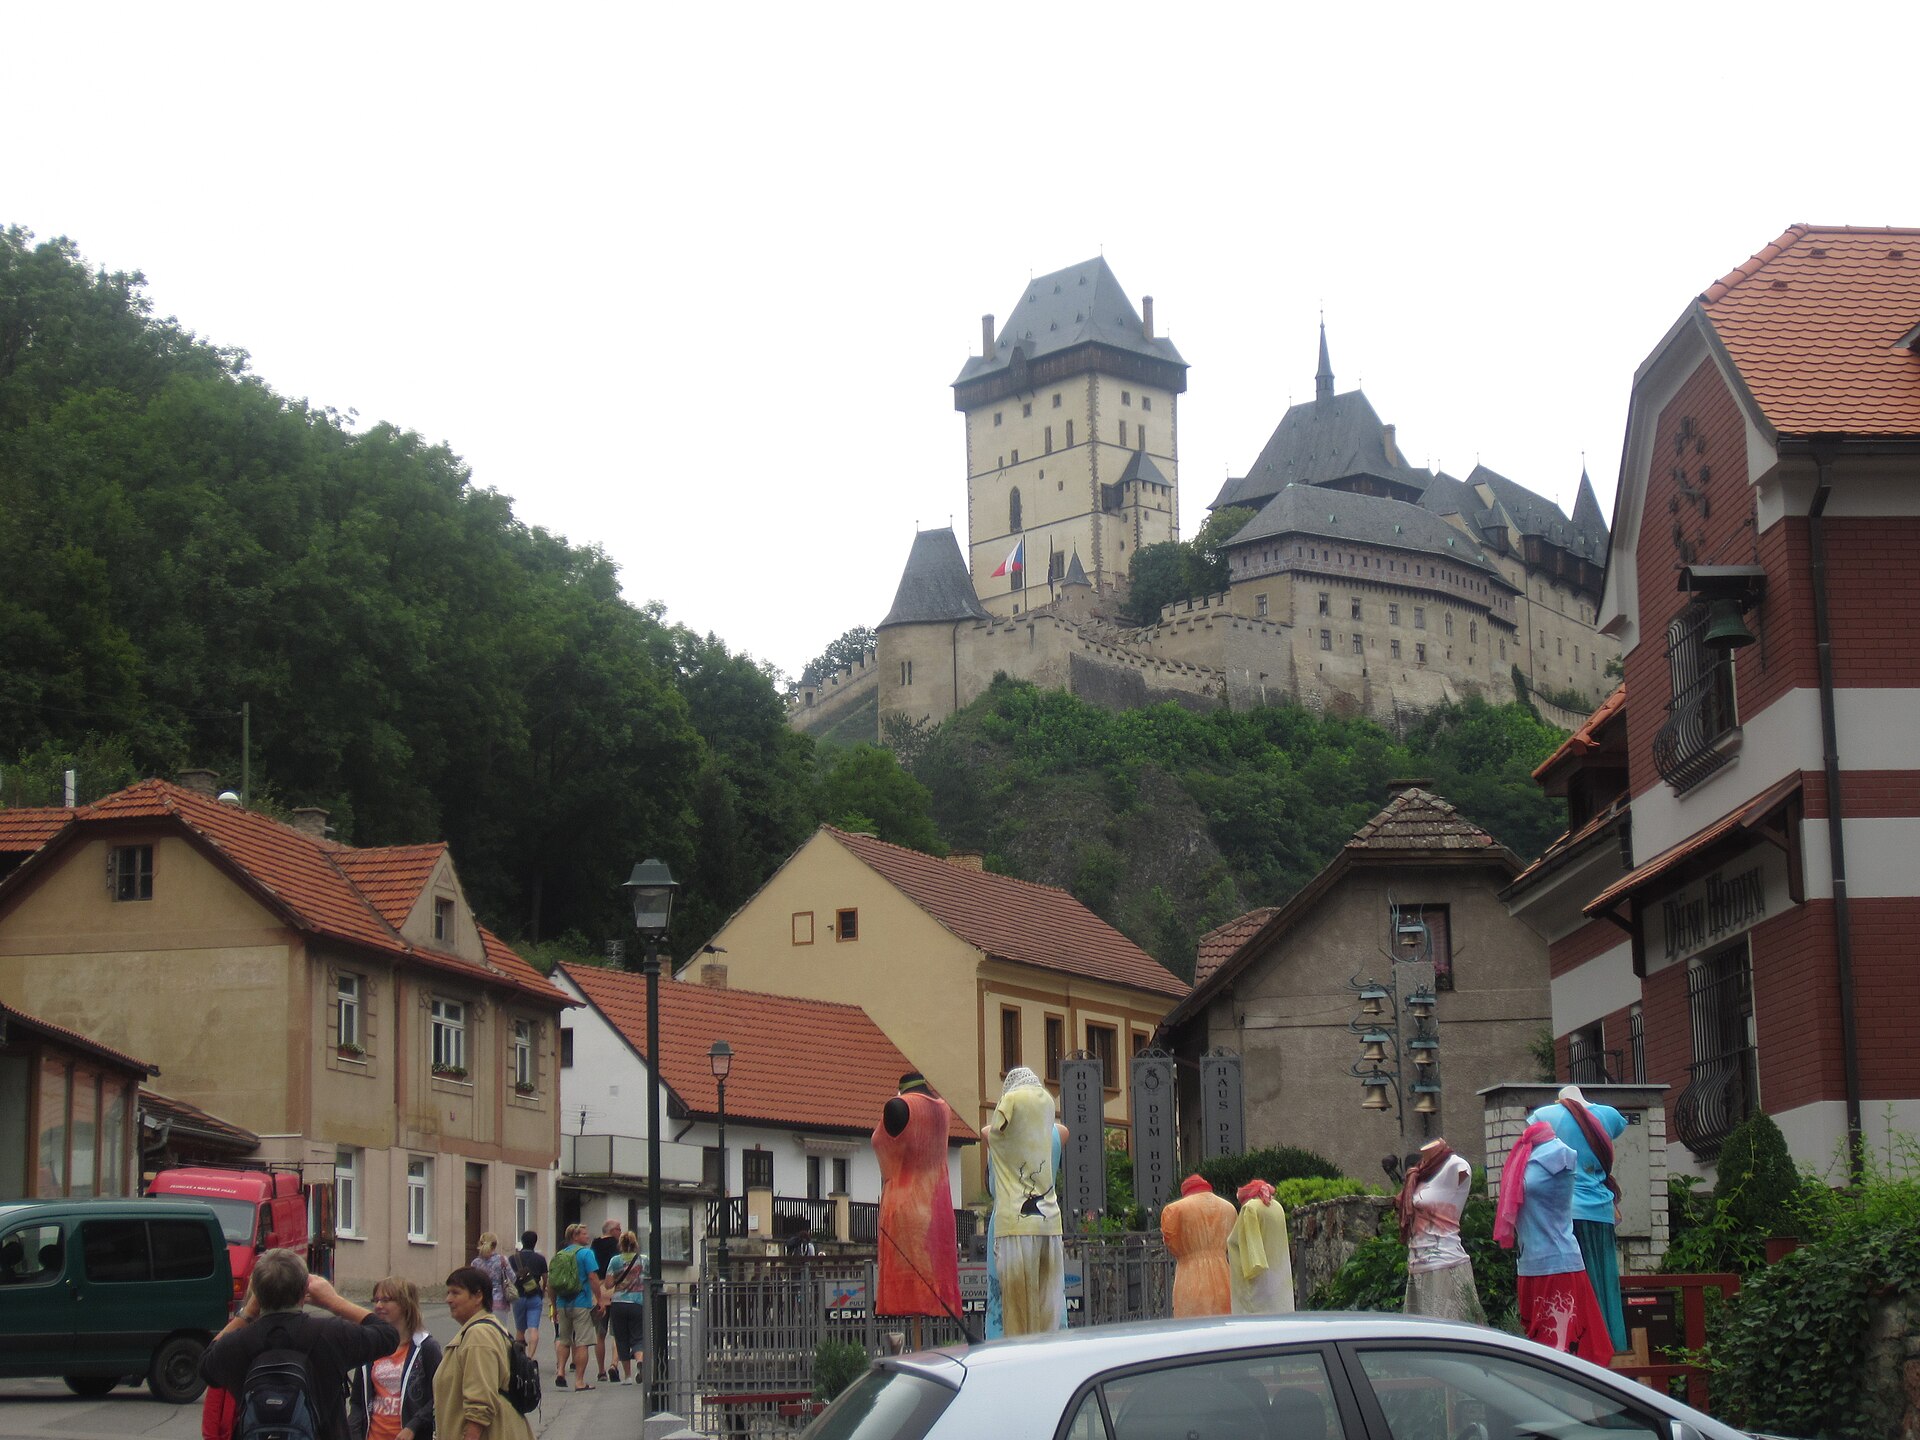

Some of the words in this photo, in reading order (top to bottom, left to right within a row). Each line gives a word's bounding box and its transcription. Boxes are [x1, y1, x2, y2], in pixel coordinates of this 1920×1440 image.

[1076, 1071, 1088, 1124] HOUSE
[1217, 1067, 1229, 1110] HAUS
[1078, 1134, 1089, 1153] OF
[1219, 1123, 1230, 1155] DER
[1150, 1151, 1161, 1206] HODIN
